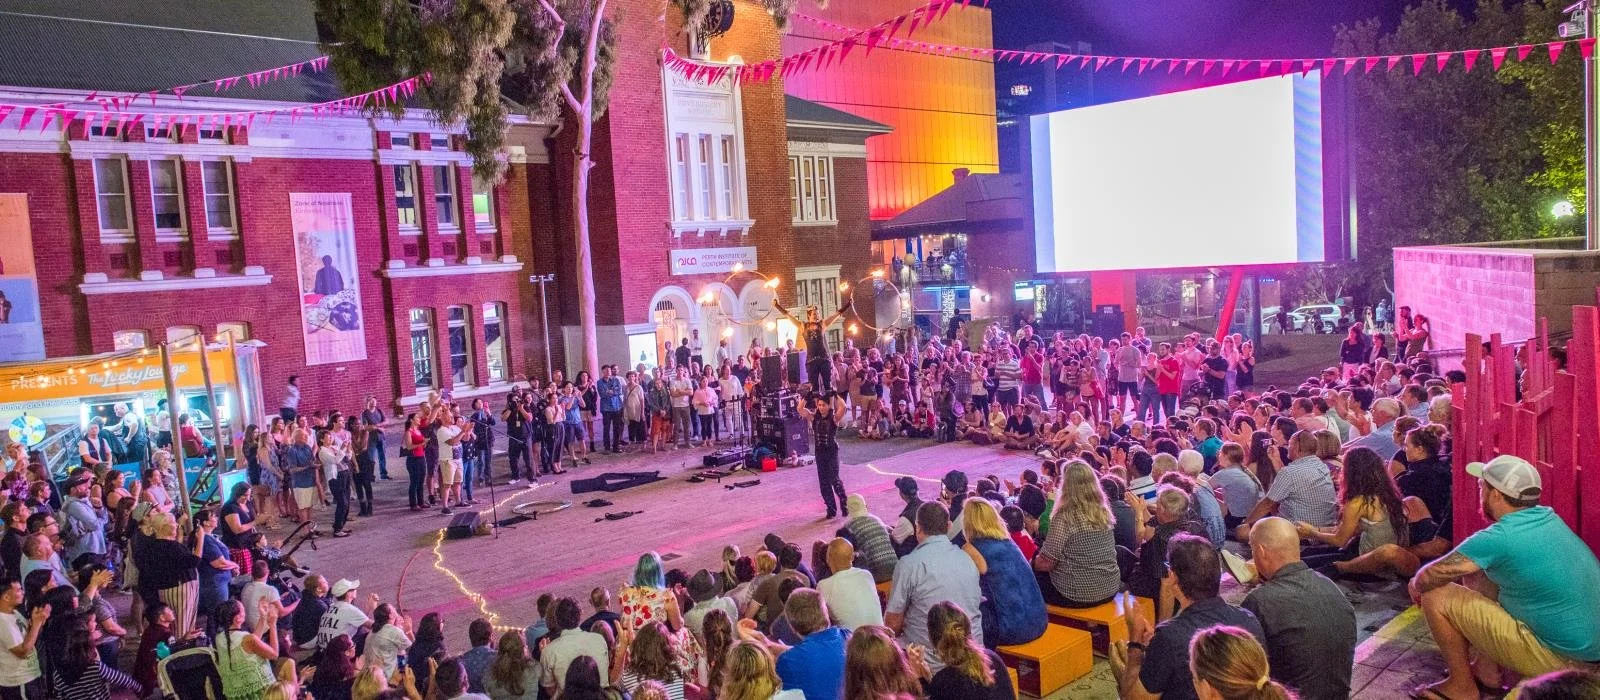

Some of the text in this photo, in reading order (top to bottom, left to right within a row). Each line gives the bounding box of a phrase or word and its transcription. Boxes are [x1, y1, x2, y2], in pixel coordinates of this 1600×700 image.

[88, 363, 188, 388] The Lucky Louge
